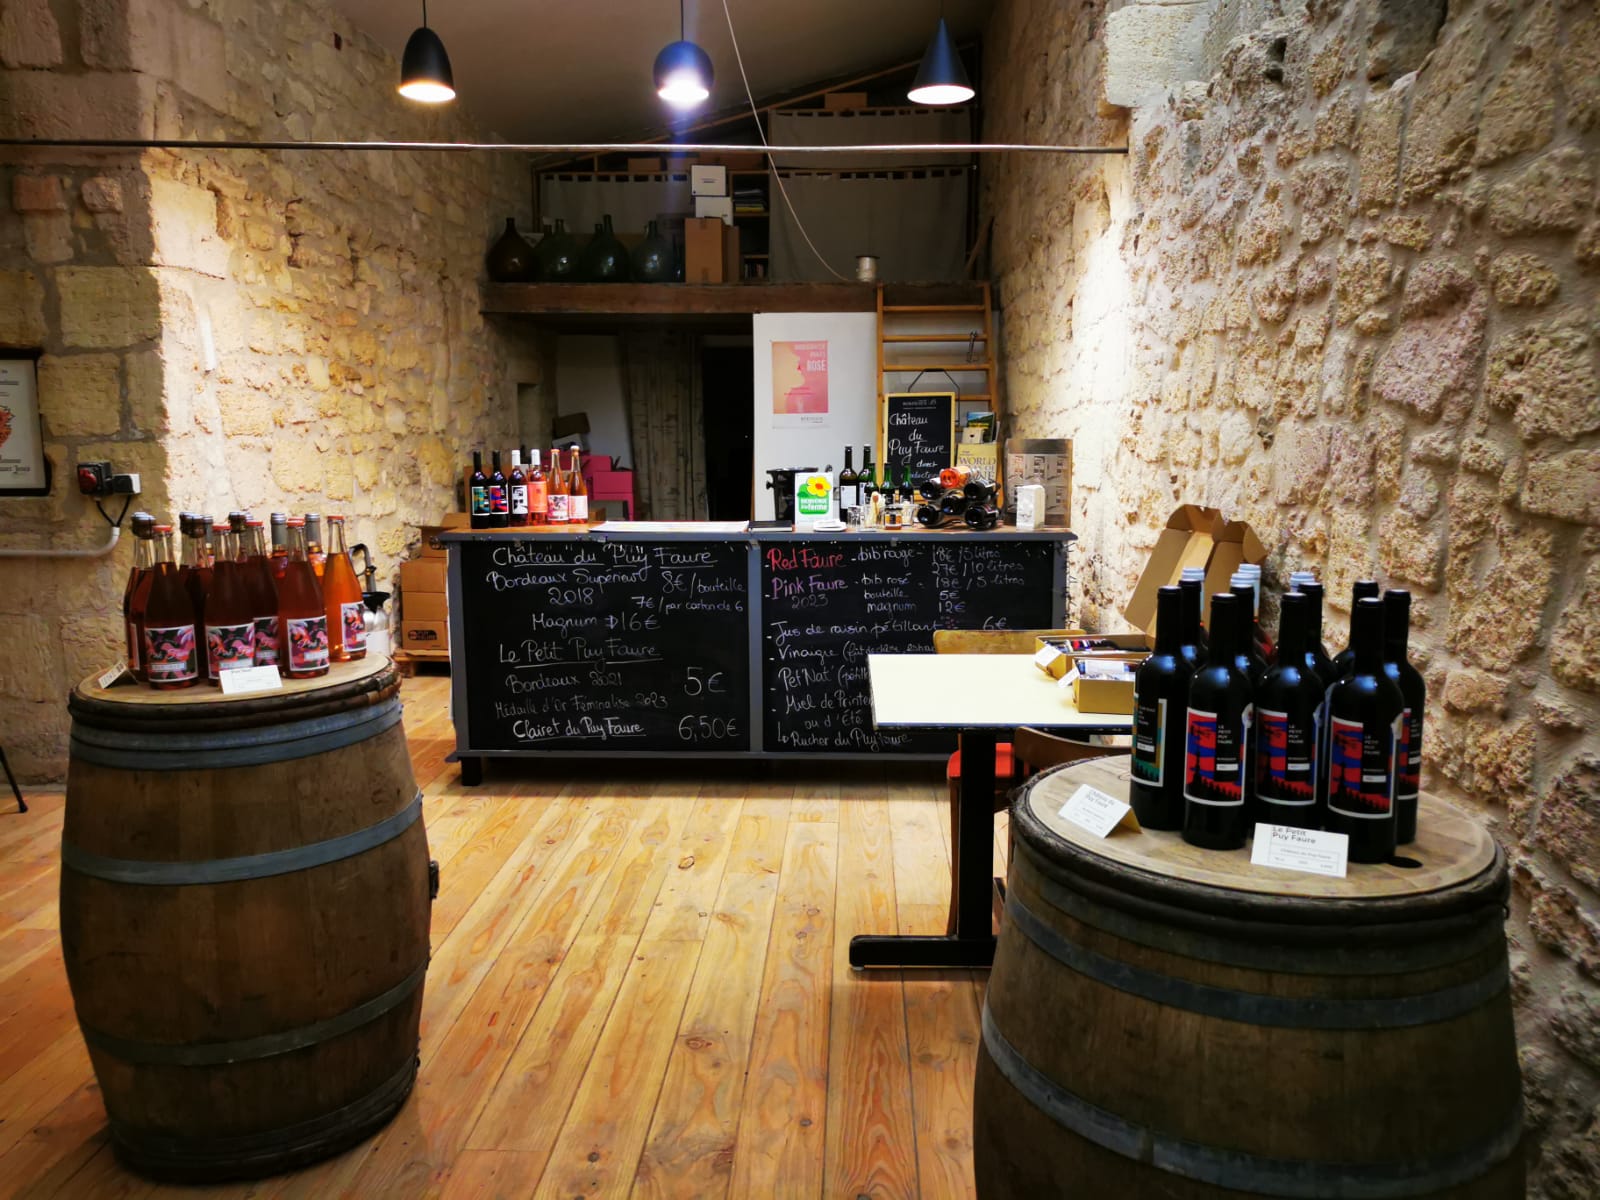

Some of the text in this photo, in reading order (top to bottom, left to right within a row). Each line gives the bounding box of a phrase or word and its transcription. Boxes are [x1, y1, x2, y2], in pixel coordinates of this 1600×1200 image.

[889, 413, 928, 425] Château
[908, 429, 923, 442] du
[888, 439, 949, 465] Puy Faure
[492, 543, 718, 581] Château du Puy Faure
[767, 548, 846, 572] Red Faure
[486, 571, 567, 591] Bordeaux
[772, 574, 848, 599] Pink Faure
[548, 587, 594, 605] 2018
[631, 596, 656, 609] 7€
[735, 600, 744, 611] 6
[792, 593, 829, 609] 2023
[938, 602, 966, 613] 12€
[532, 612, 598, 639] Magnum
[770, 621, 801, 646] Jus
[806, 624, 825, 636] de
[830, 621, 867, 634] raisin
[983, 616, 1008, 630] 6€
[499, 636, 661, 673] Le Petit Puy Faure
[505, 671, 622, 693] Bordeaux 2021
[635, 690, 669, 708] 2023
[786, 693, 816, 714] Miel
[820, 694, 834, 709] de
[513, 715, 645, 740] Clairet du Puy Faure
[679, 714, 740, 742] 6,50€
[804, 718, 818, 729] ou
[790, 731, 830, 747] Rucher
[834, 732, 852, 746] du
[1272, 831, 1316, 844] Puy Faure
